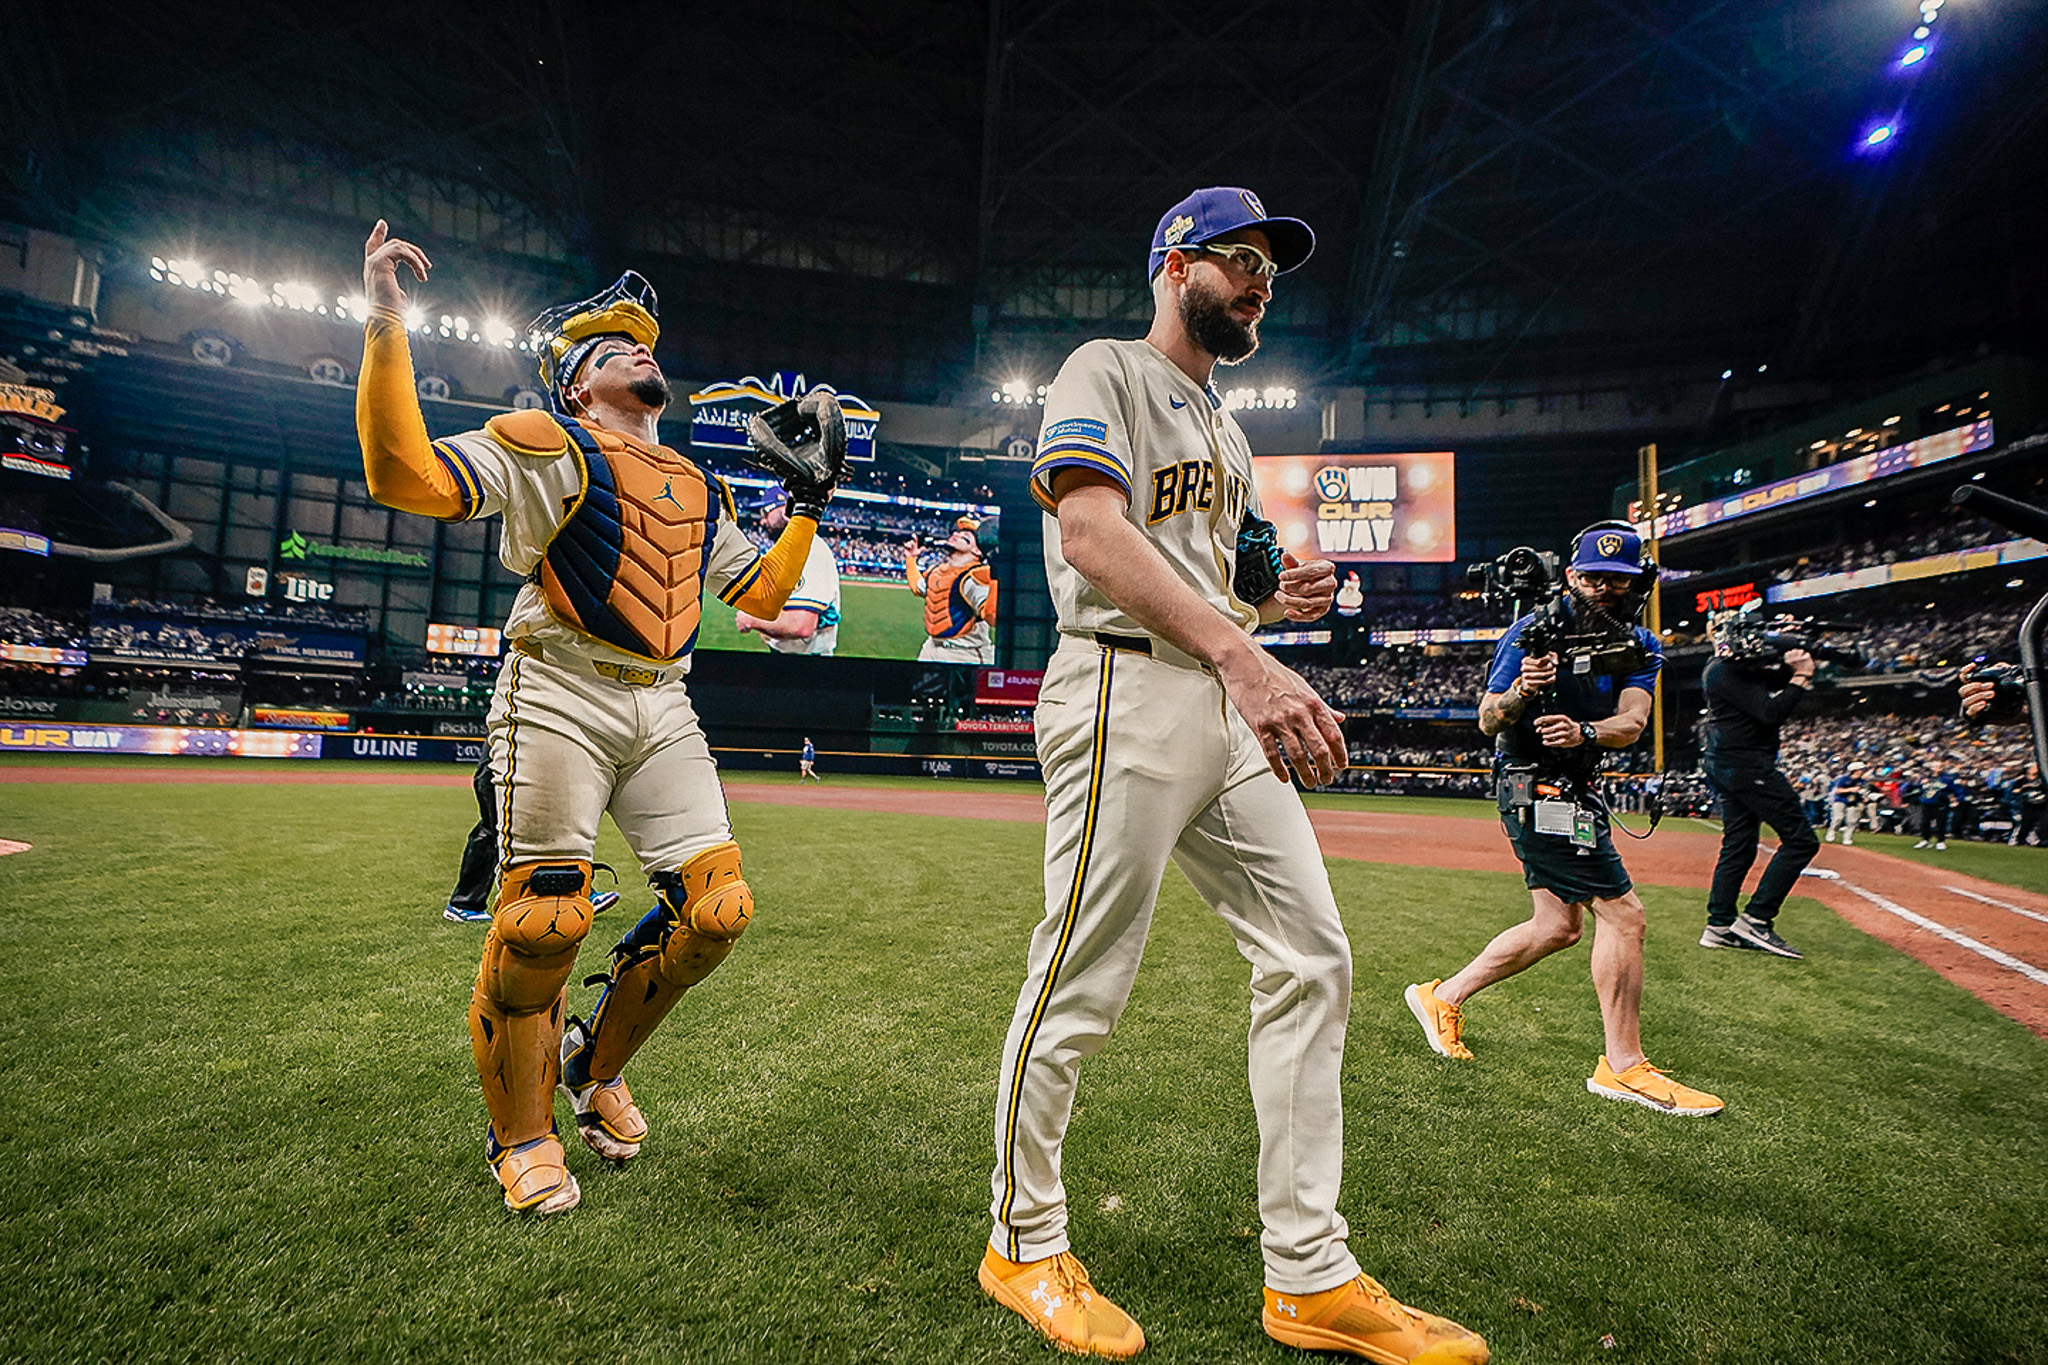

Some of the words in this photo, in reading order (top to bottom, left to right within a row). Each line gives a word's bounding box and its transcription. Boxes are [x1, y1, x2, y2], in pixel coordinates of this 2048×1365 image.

[1013, 444, 1030, 457] 19
[1318, 502, 1393, 520] OUR
[1316, 519, 1395, 553] WAY
[284, 576, 334, 603] Lite
[958, 722, 988, 731] TOYOTA
[989, 722, 1030, 732] TERRITORY
[72, 730, 122, 748] WAY
[353, 738, 418, 758] ULINE
[982, 742, 1036, 752] TOYOTA.CO
